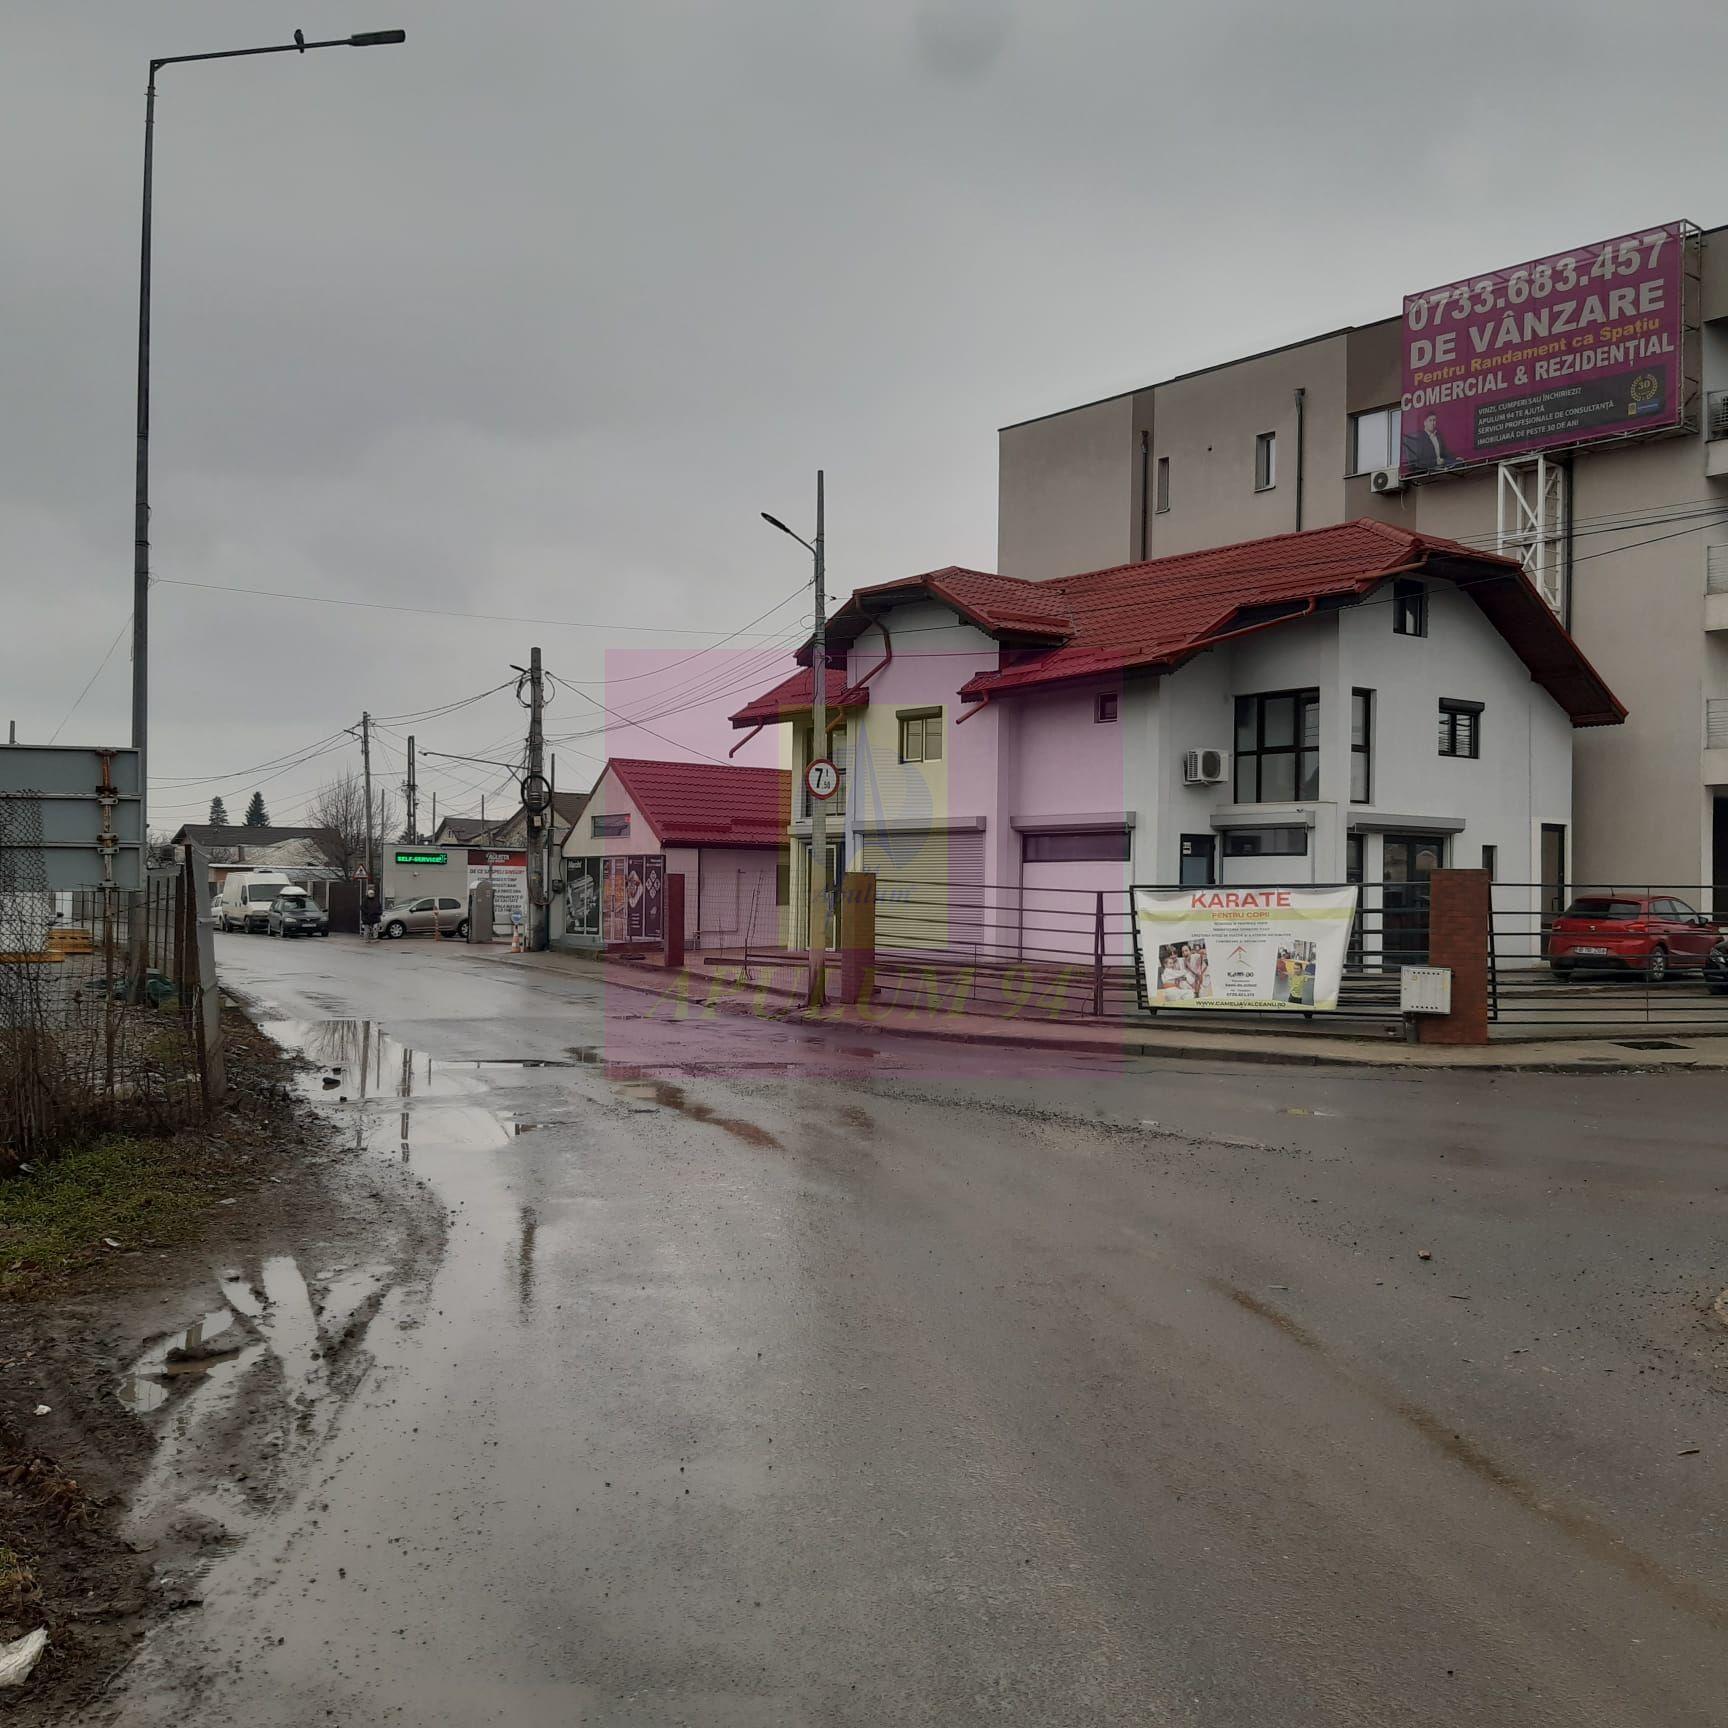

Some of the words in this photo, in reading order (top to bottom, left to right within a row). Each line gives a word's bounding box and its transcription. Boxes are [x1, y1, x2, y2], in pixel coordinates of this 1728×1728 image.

[1408, 232, 1667, 331] 0733.683.457
[1410, 332, 1456, 370] DE
[1469, 278, 1665, 353] VÂNZARE
[1414, 363, 1465, 386] Pentru
[1470, 338, 1567, 372] Randament
[1572, 333, 1594, 348] ca
[1401, 373, 1508, 411] COMERCIAL
[1514, 364, 1528, 386] &
[1535, 333, 1674, 383] REZIDENȚIAL
[1478, 413, 1505, 425] APULUM
[1504, 413, 1553, 429] PROFESIONALE
[1554, 411, 1564, 419] DE
[1526, 425, 1545, 436] PESTE
[1557, 421, 1565, 430] DE
[1566, 418, 1579, 428] ANI
[815, 768, 823, 788] 7
[1191, 891, 1291, 908] KARATE
[1212, 911, 1244, 919] PENTRU
[1246, 911, 1270, 919] COPII
